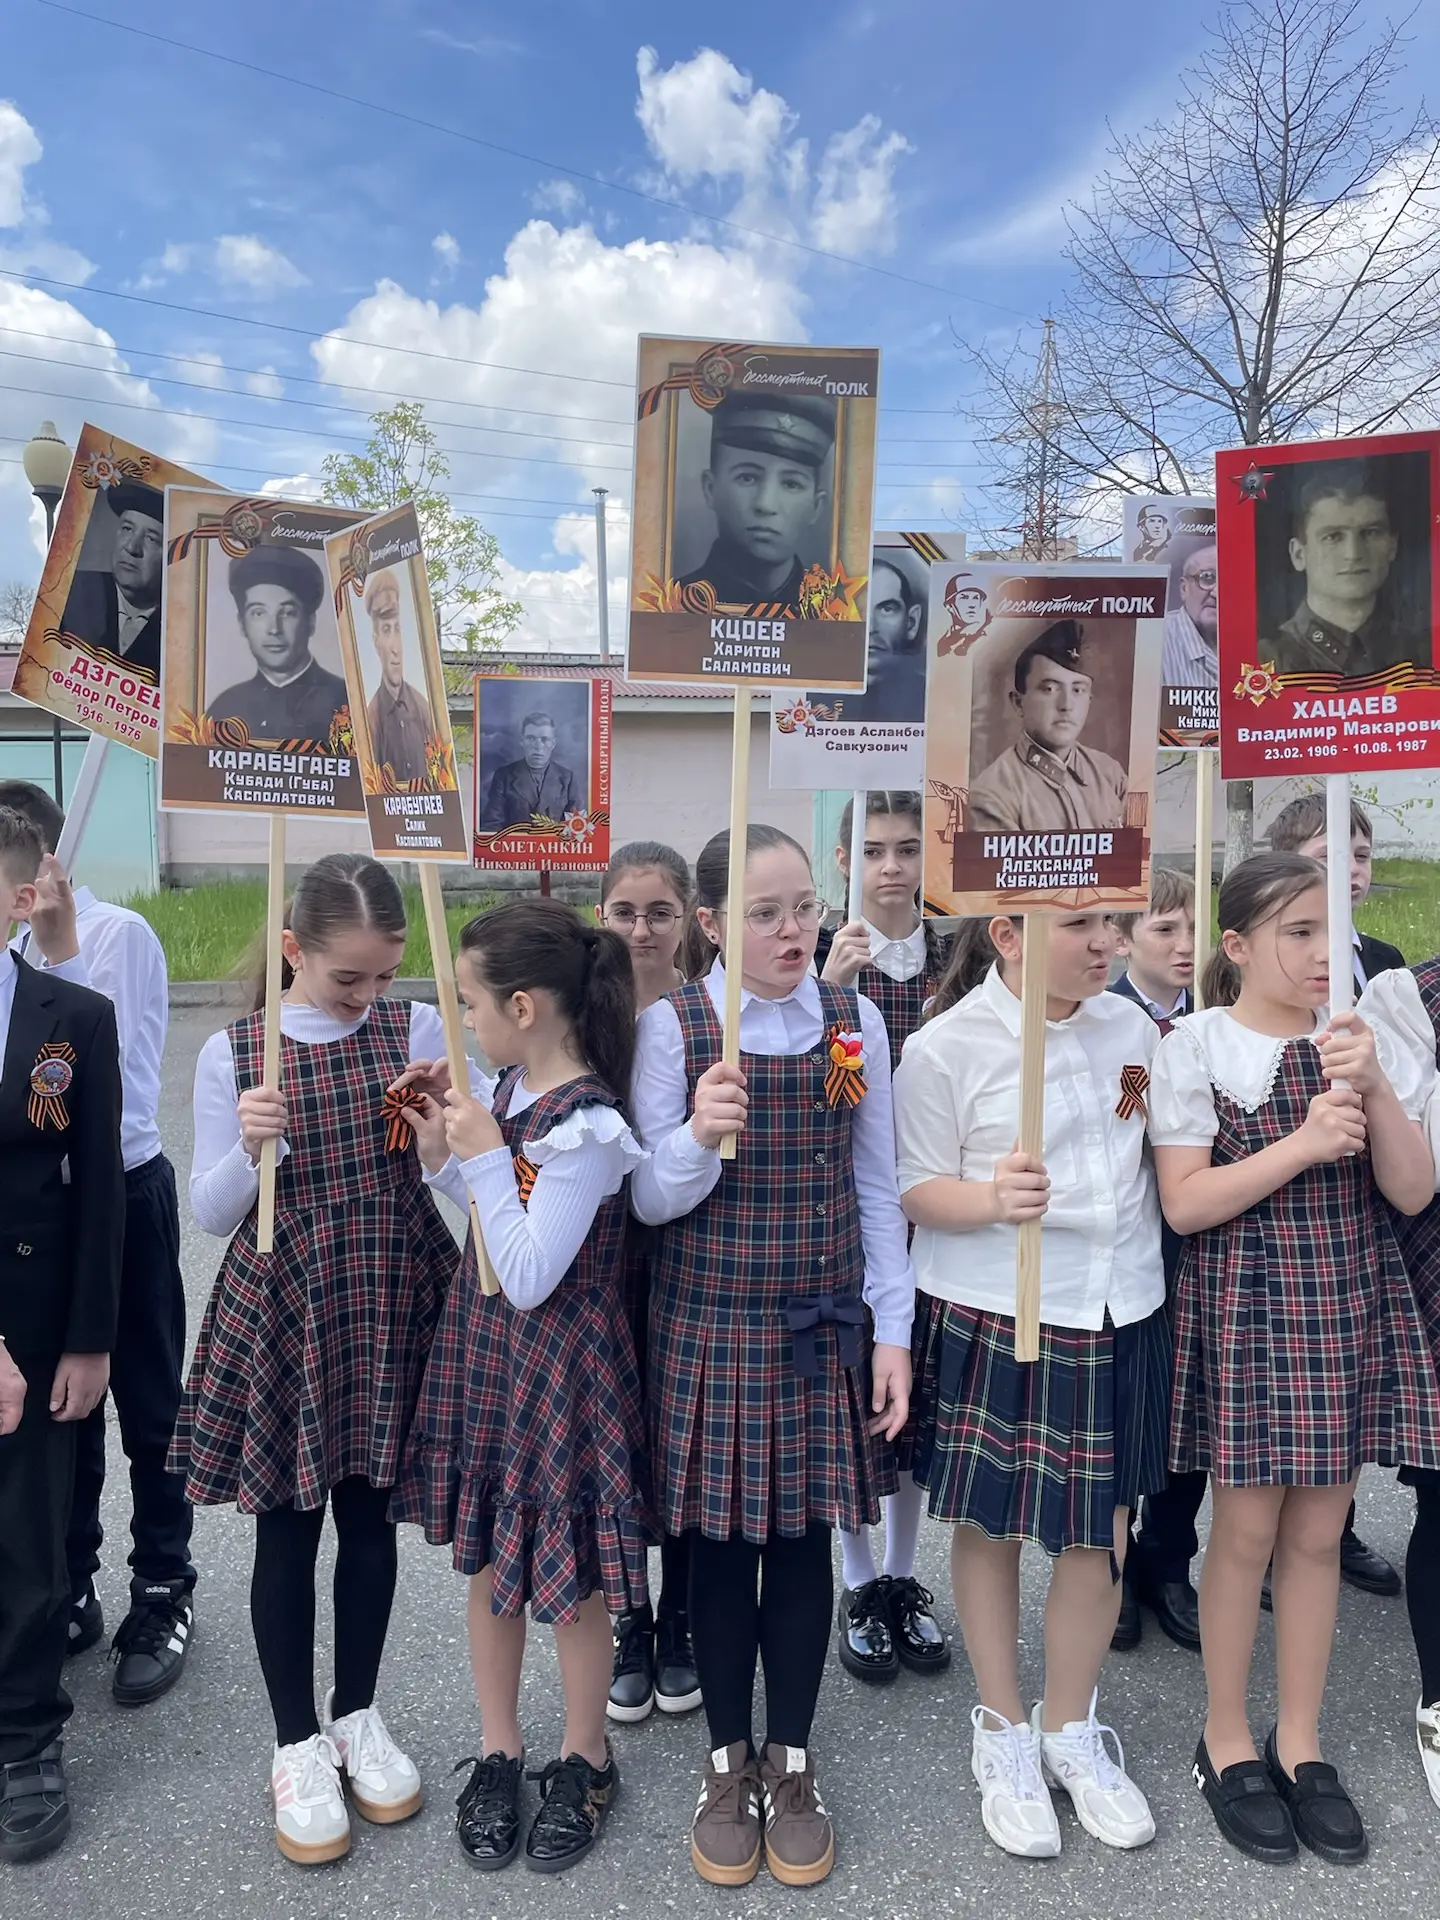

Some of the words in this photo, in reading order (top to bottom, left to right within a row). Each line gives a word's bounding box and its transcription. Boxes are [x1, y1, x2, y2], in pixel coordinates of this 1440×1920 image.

[826, 381, 869, 396] ПОЛК
[1102, 596, 1155, 614] ПОЛК
[710, 618, 786, 641] КЦОЕВ
[52, 671, 101, 704] Фёдор
[104, 694, 160, 730] Петров
[600, 679, 610, 713] ПОЛК
[1168, 689, 1218, 706] НИКК
[1292, 695, 1398, 720] ХАЦАЕВ
[76, 703, 104, 723] 1916
[114, 720, 142, 741] 1976
[805, 726, 856, 738] Дзгоев
[1237, 724, 1338, 743] Владимир
[825, 740, 908, 754] Савкузович
[1264, 747, 1304, 760] 23.02.
[1307, 745, 1338, 758] 1906
[1353, 742, 1392, 755] 10.08.
[1396, 740, 1428, 753] 1987
[208, 749, 351, 777] КАРАБУГАЕВ
[598, 716, 609, 805] БЕССМЕРТНЫЙ
[383, 794, 444, 816] КАРАБУГАЕВ
[489, 839, 593, 854] СМЕТАНКИН
[983, 833, 1114, 858] НИККОЛОВ
[474, 857, 536, 871] Николай
[541, 859, 609, 872] Иванович
[145, 1585, 171, 1594] adidas
